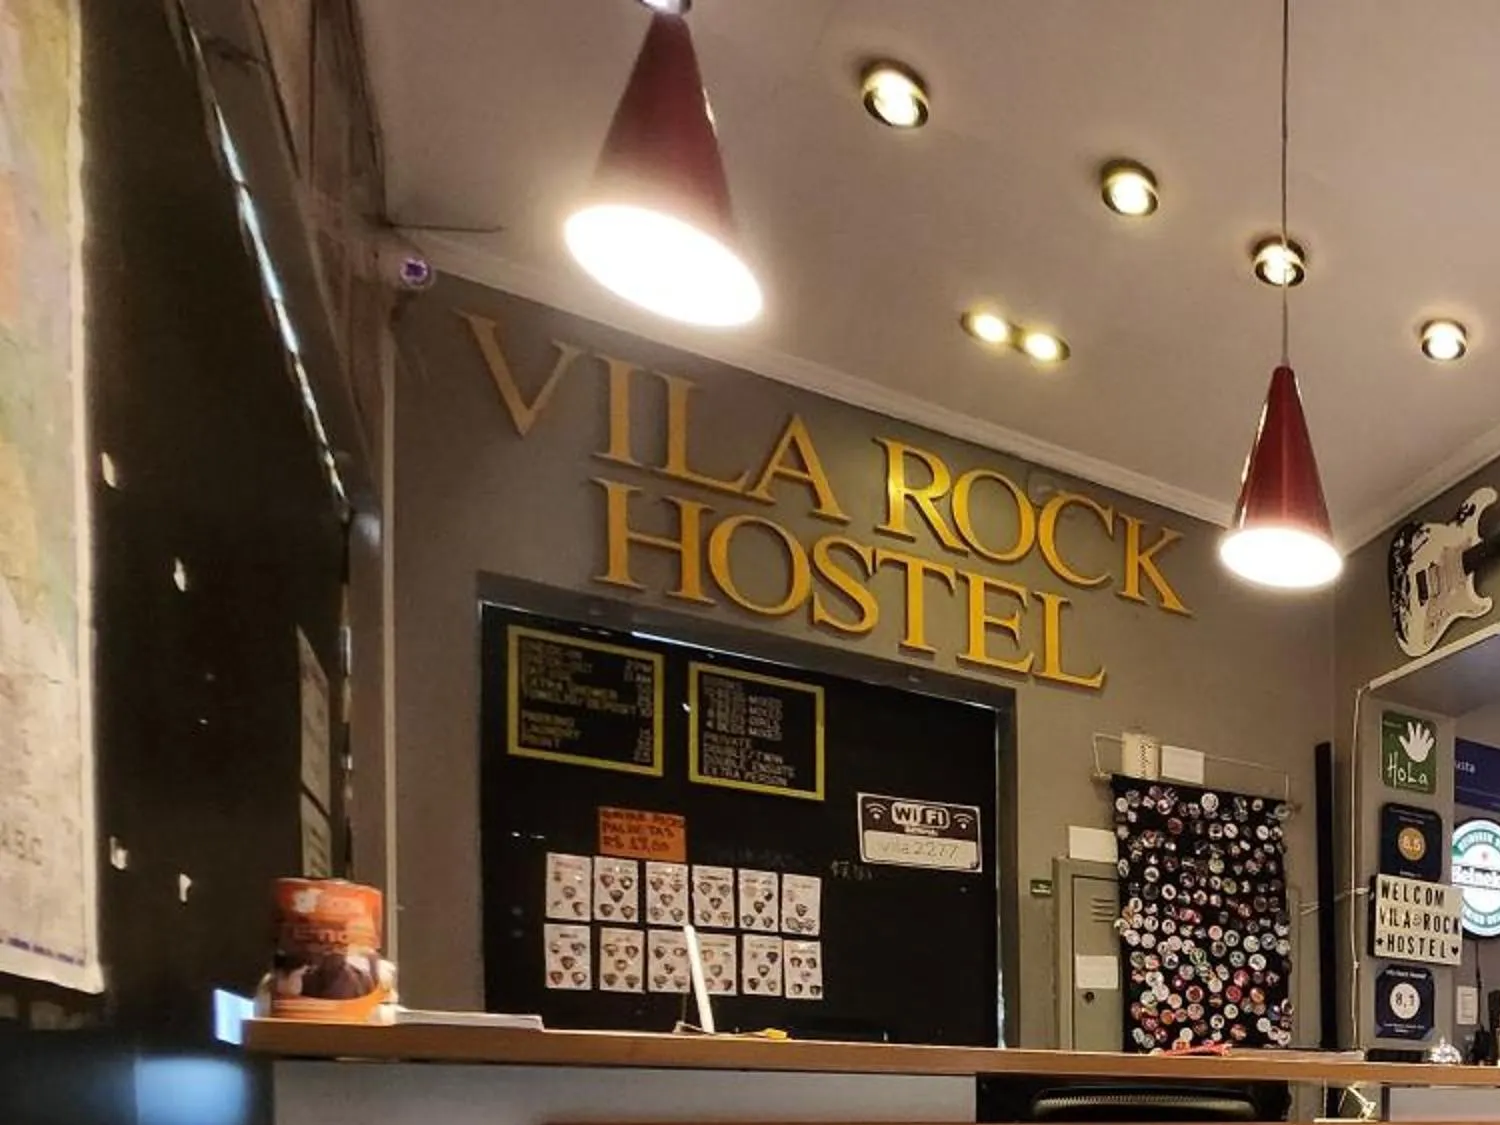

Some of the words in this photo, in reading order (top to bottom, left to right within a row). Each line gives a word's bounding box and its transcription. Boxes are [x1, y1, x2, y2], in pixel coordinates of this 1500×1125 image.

[457, 312, 852, 525] VILA
[874, 436, 1195, 618] ROCK
[593, 477, 1107, 690] HOSTEL
[1381, 880, 1445, 907] WELCOM
[1379, 907, 1410, 929] VILA
[1424, 913, 1459, 935] ROCK
[1387, 934, 1446, 958] HOSTEL
